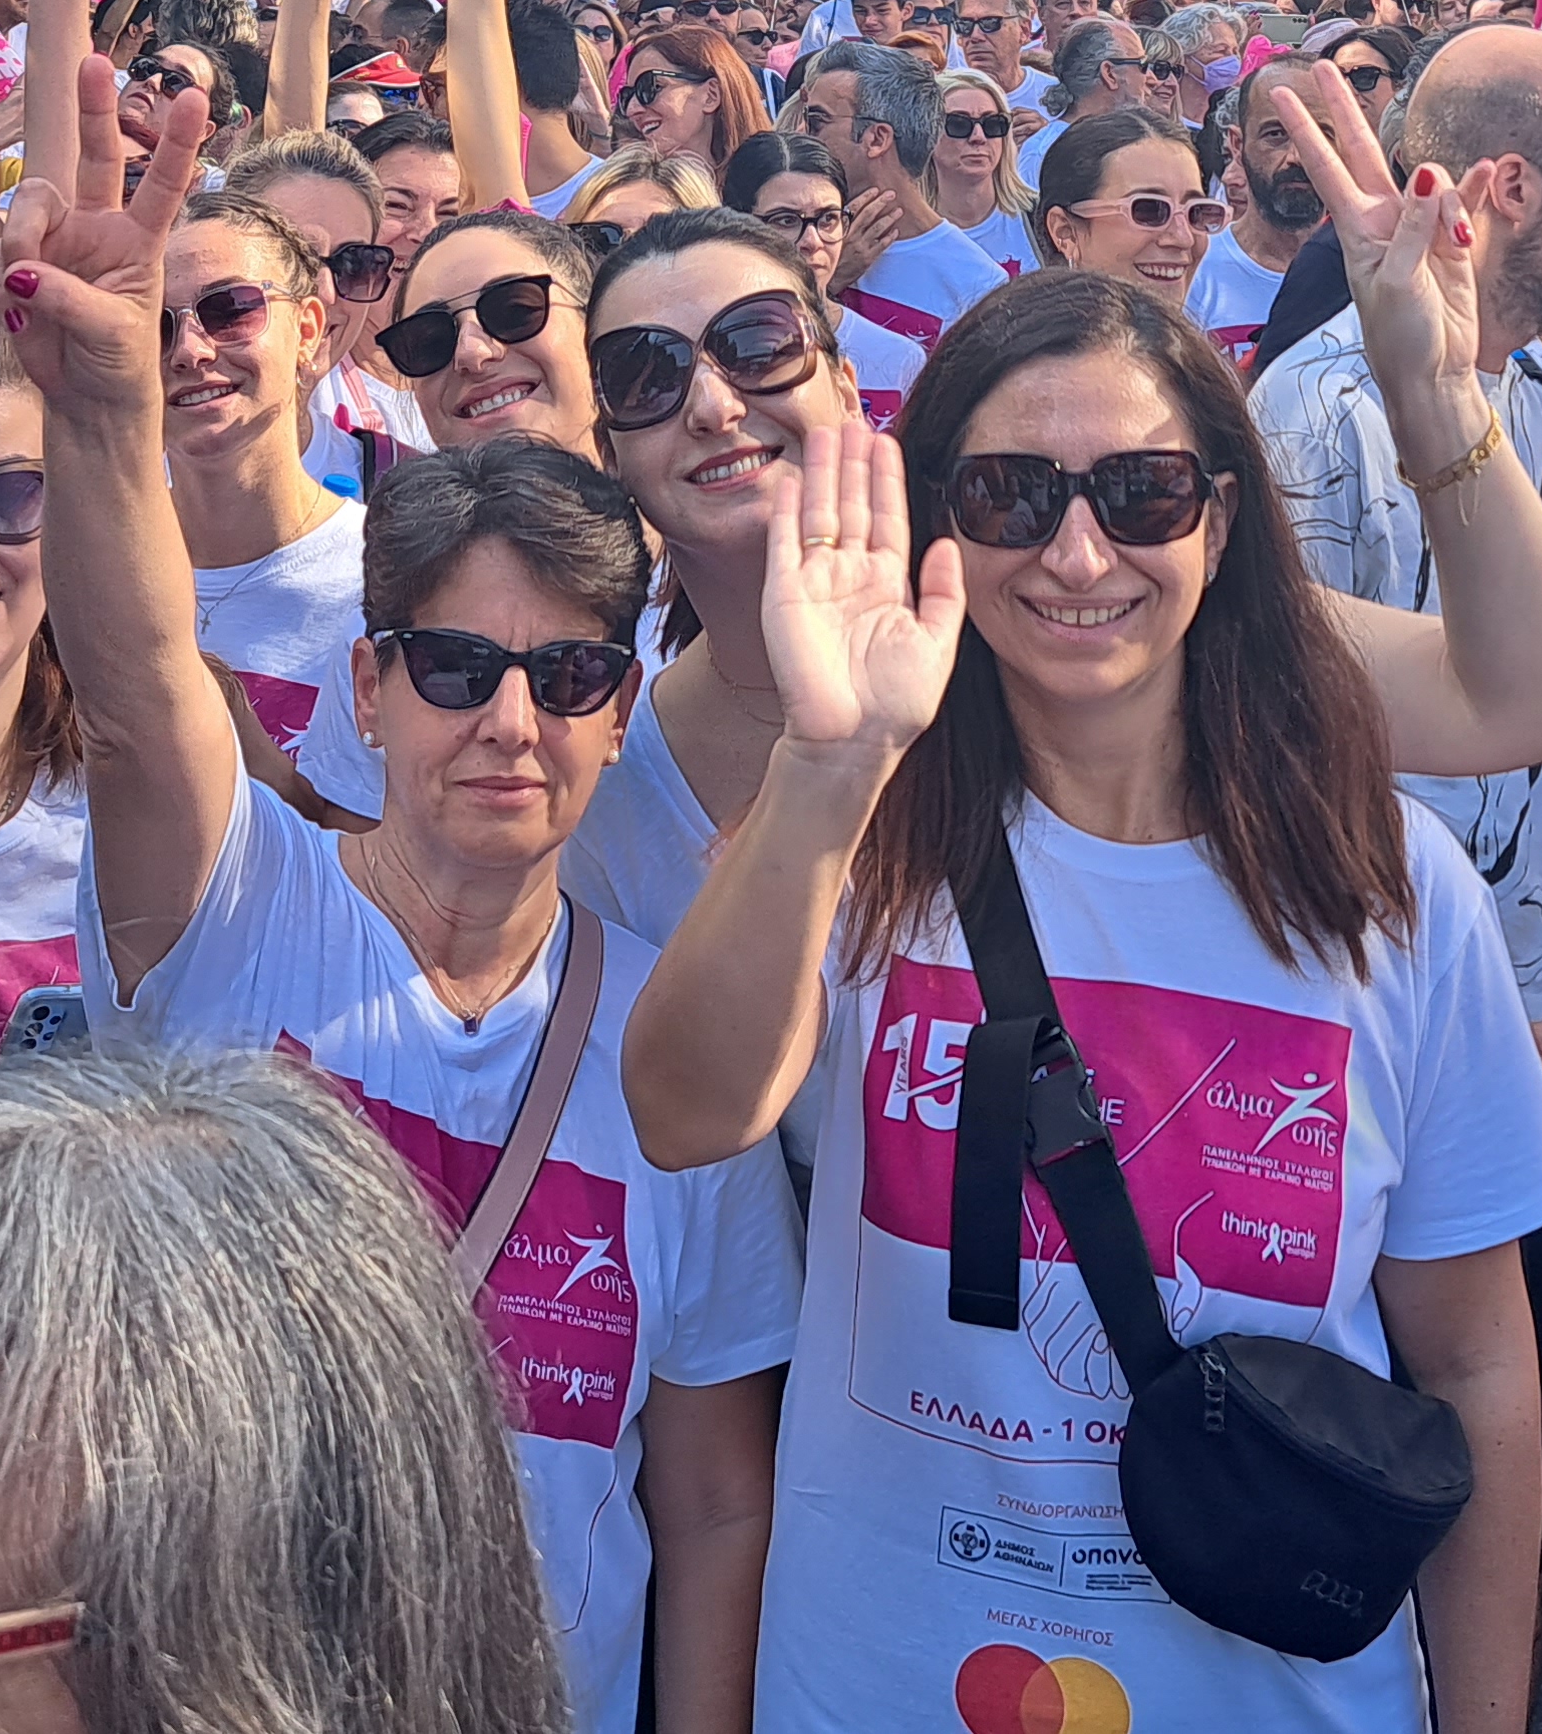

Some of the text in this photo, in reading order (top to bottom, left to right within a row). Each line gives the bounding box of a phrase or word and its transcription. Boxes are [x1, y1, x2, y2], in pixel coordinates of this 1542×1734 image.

[882, 1012, 975, 1131] 15
[893, 1035, 908, 1095] YEARS
[1206, 1081, 1275, 1120] άλμα
[1221, 1210, 1318, 1251] think pink
[504, 1233, 572, 1270] άλμα
[521, 1356, 616, 1394] think pink
[910, 1390, 1034, 1443] ΕΛΛΑΔΑ
[1061, 1418, 1073, 1442] 1
[1084, 1420, 1126, 1445] ΟΚ
[993, 1550, 1055, 1574] ΑΘΗΝΑΙΩΝ
[994, 1538, 1037, 1557] ΔΗΜΟΣ
[986, 1608, 1115, 1646] ΜΕΓΑΣ ΧΟΡΗΓΟΣ
